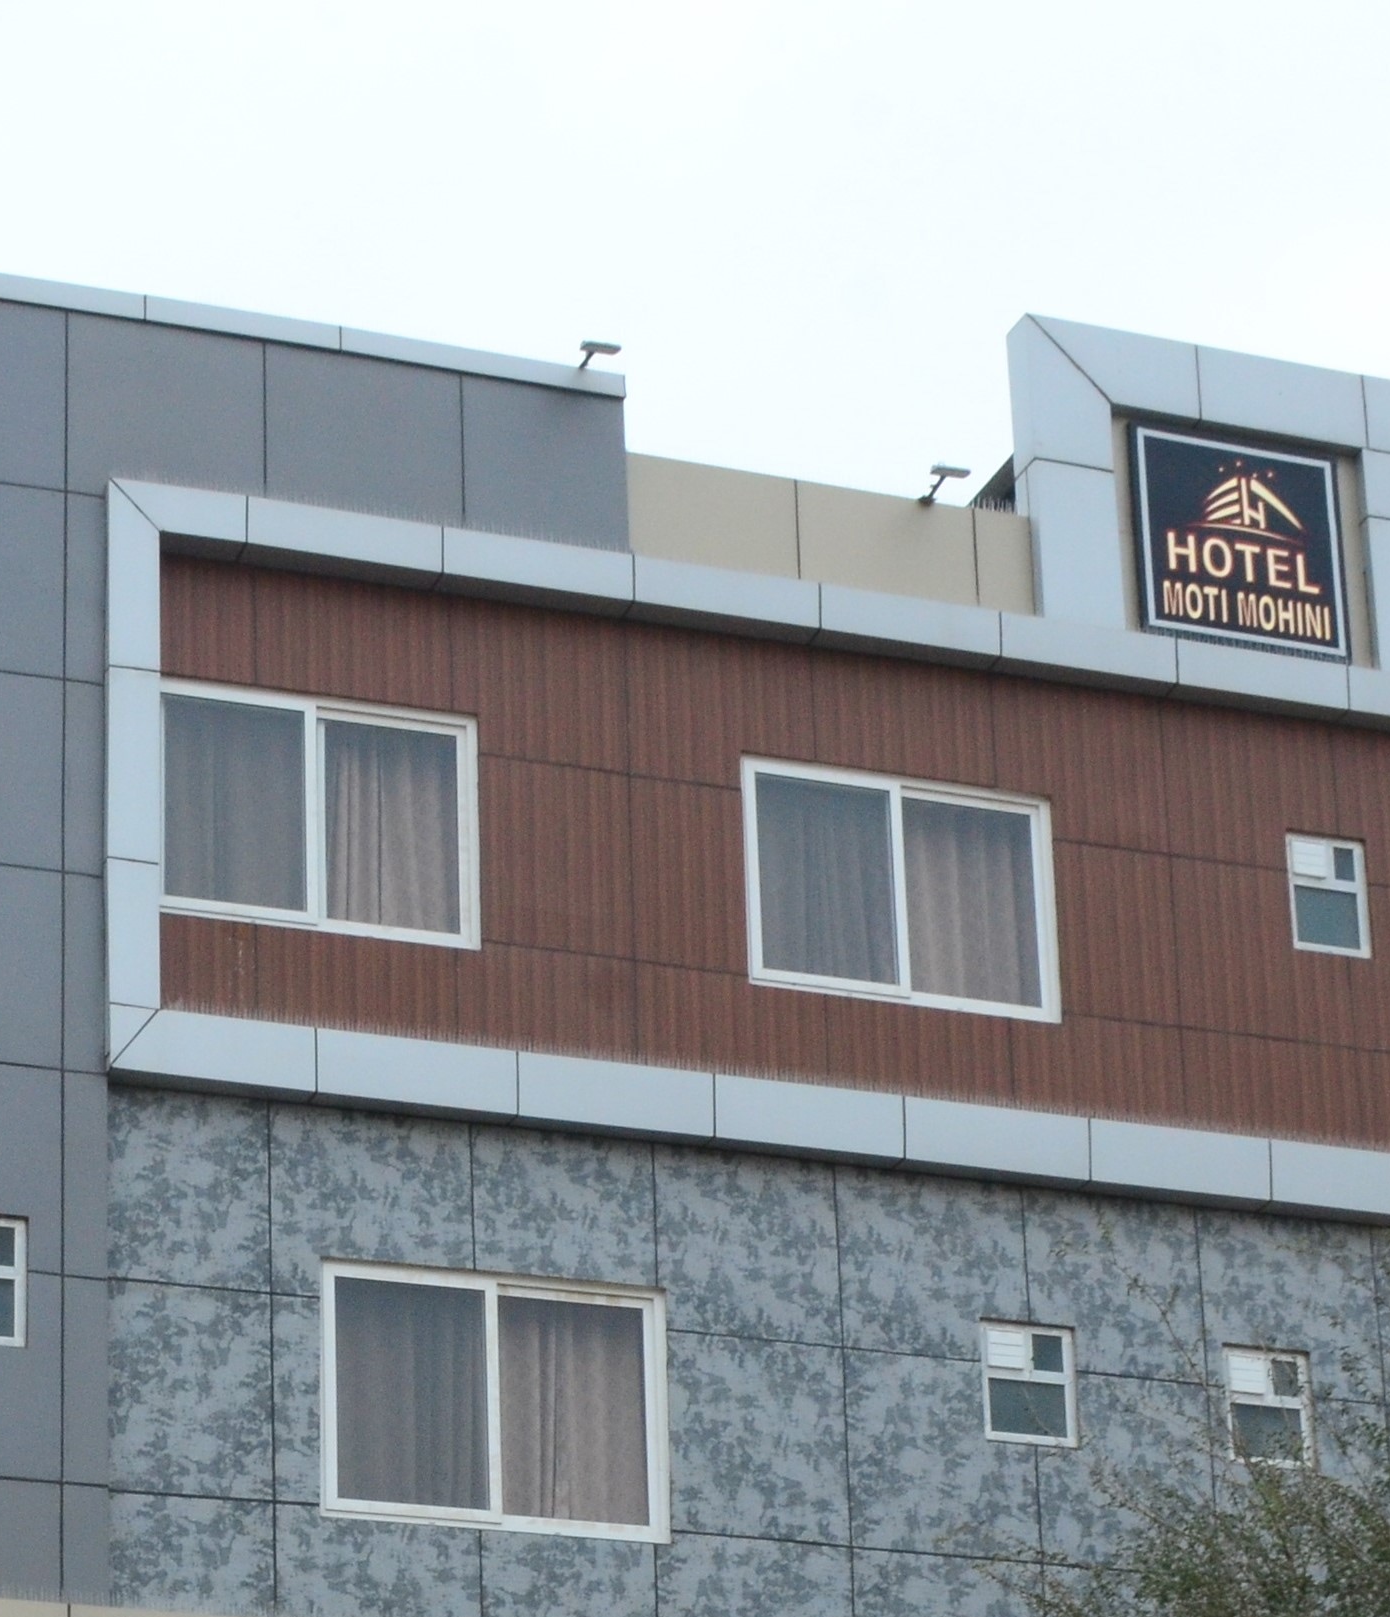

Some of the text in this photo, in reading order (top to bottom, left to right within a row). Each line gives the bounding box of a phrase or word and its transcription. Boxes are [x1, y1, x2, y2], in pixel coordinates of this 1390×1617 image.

[1166, 530, 1321, 596] HOTEL
[1162, 579, 1332, 641] MOTI MOHINI
